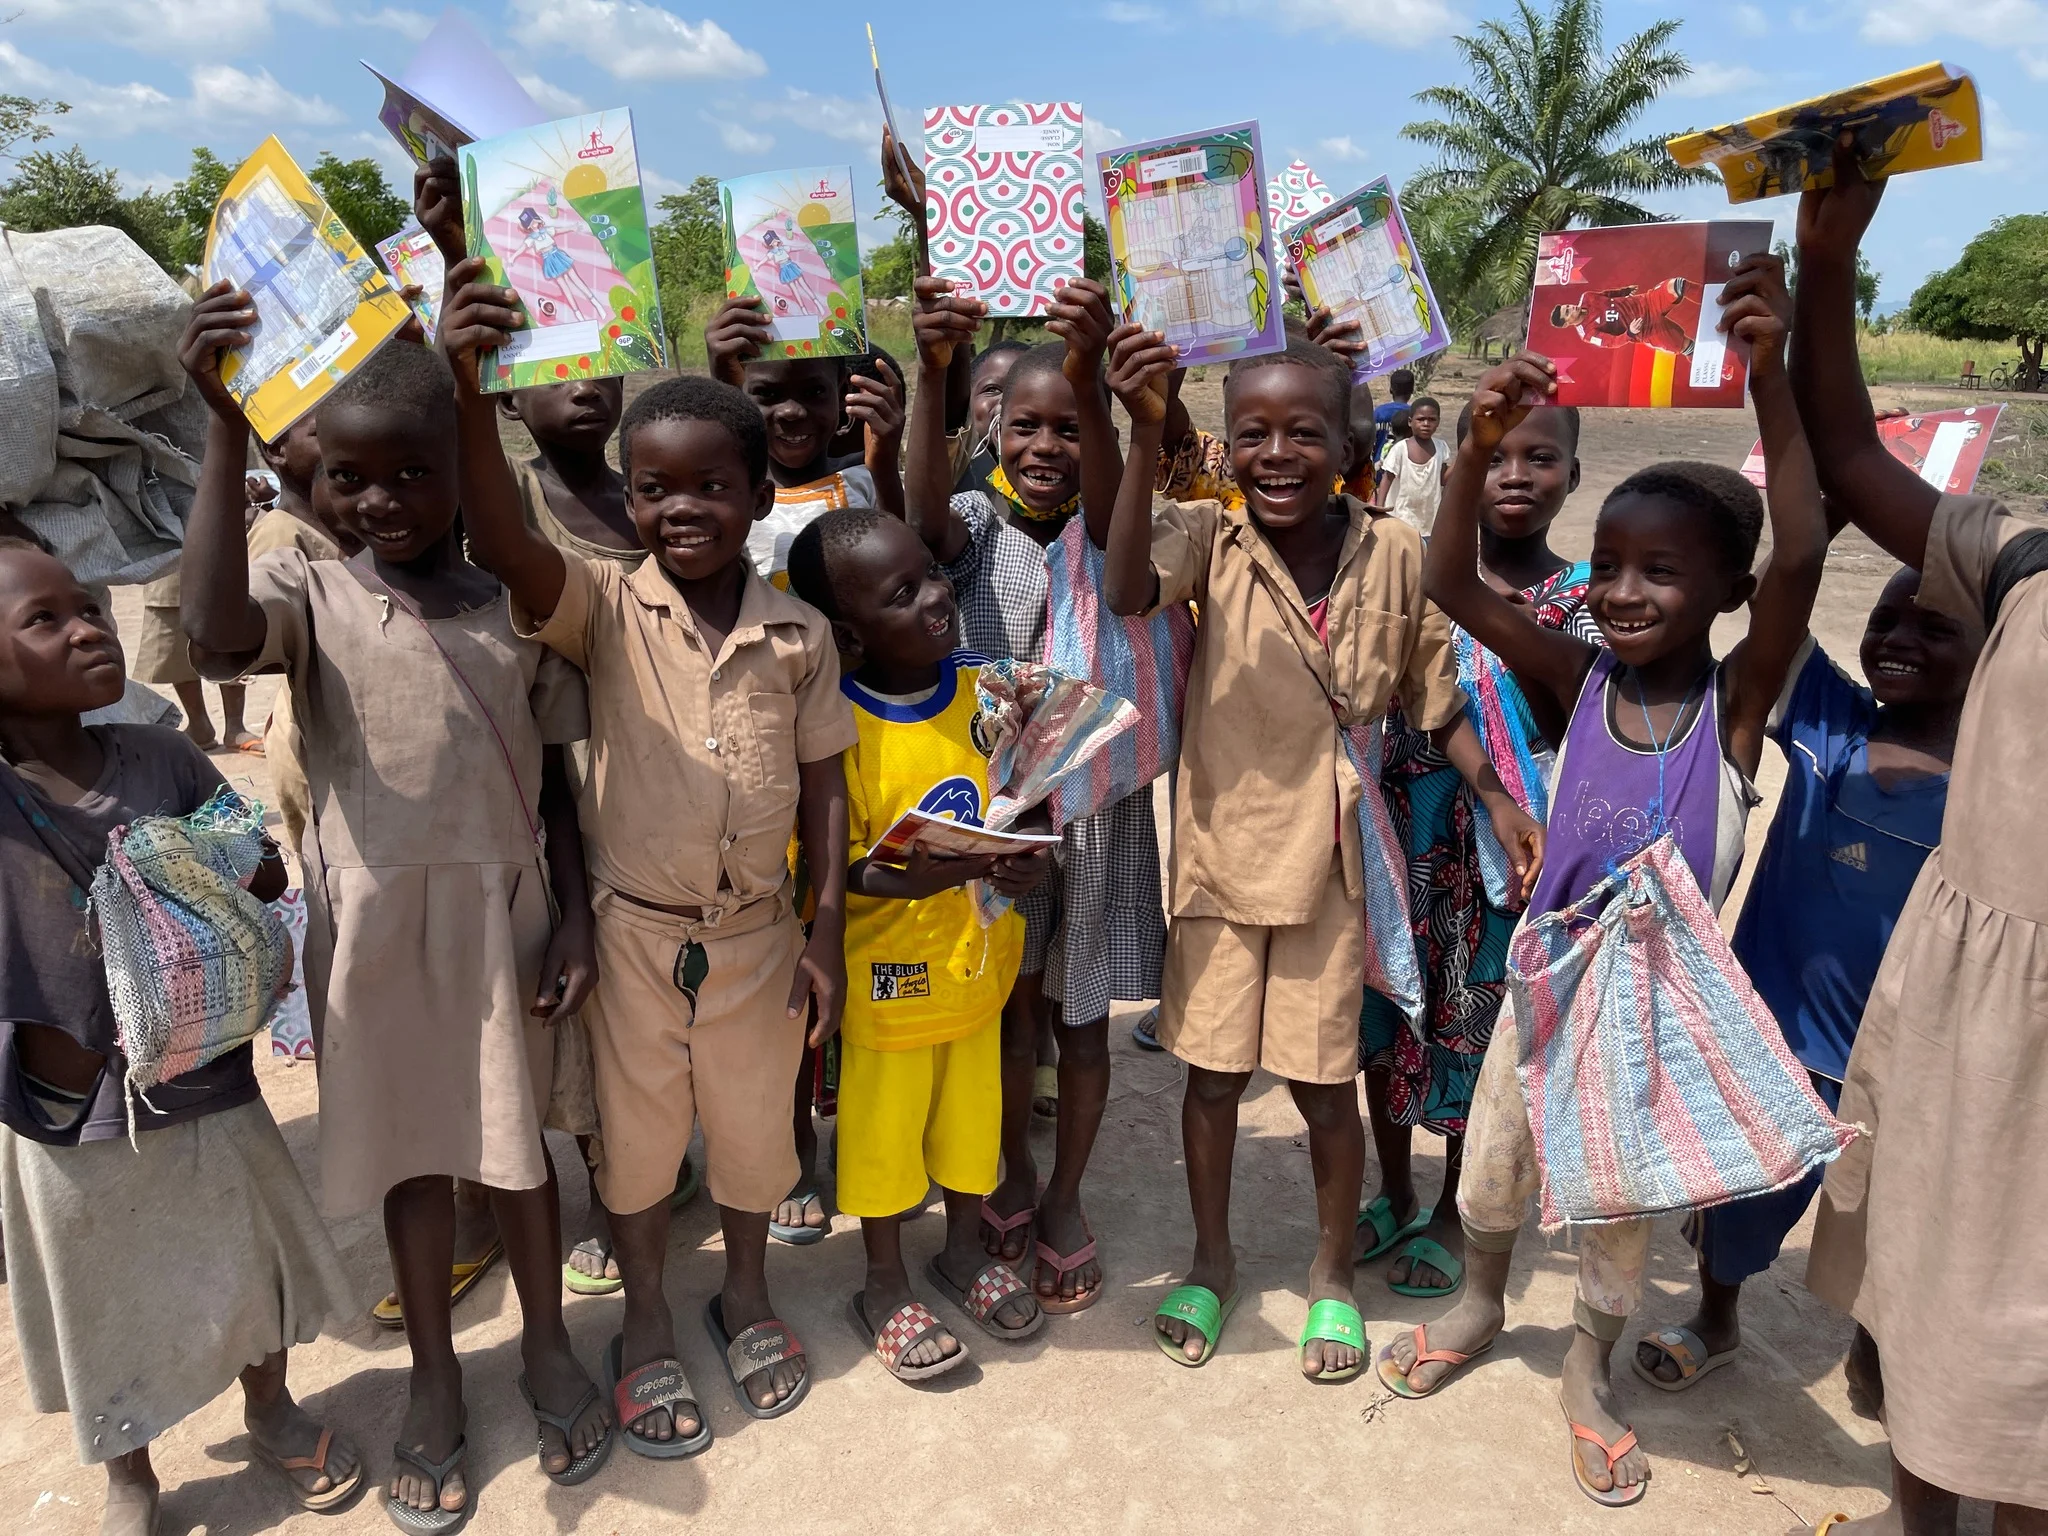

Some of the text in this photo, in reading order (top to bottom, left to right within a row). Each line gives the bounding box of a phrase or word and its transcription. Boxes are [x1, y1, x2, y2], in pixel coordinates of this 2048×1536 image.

[580, 148, 612, 157] Archer
[1562, 249, 1572, 282] Archer
[618, 336, 632, 344] 96P
[874, 964, 925, 976] THE BLUES
[634, 1374, 677, 1398] SPORT
